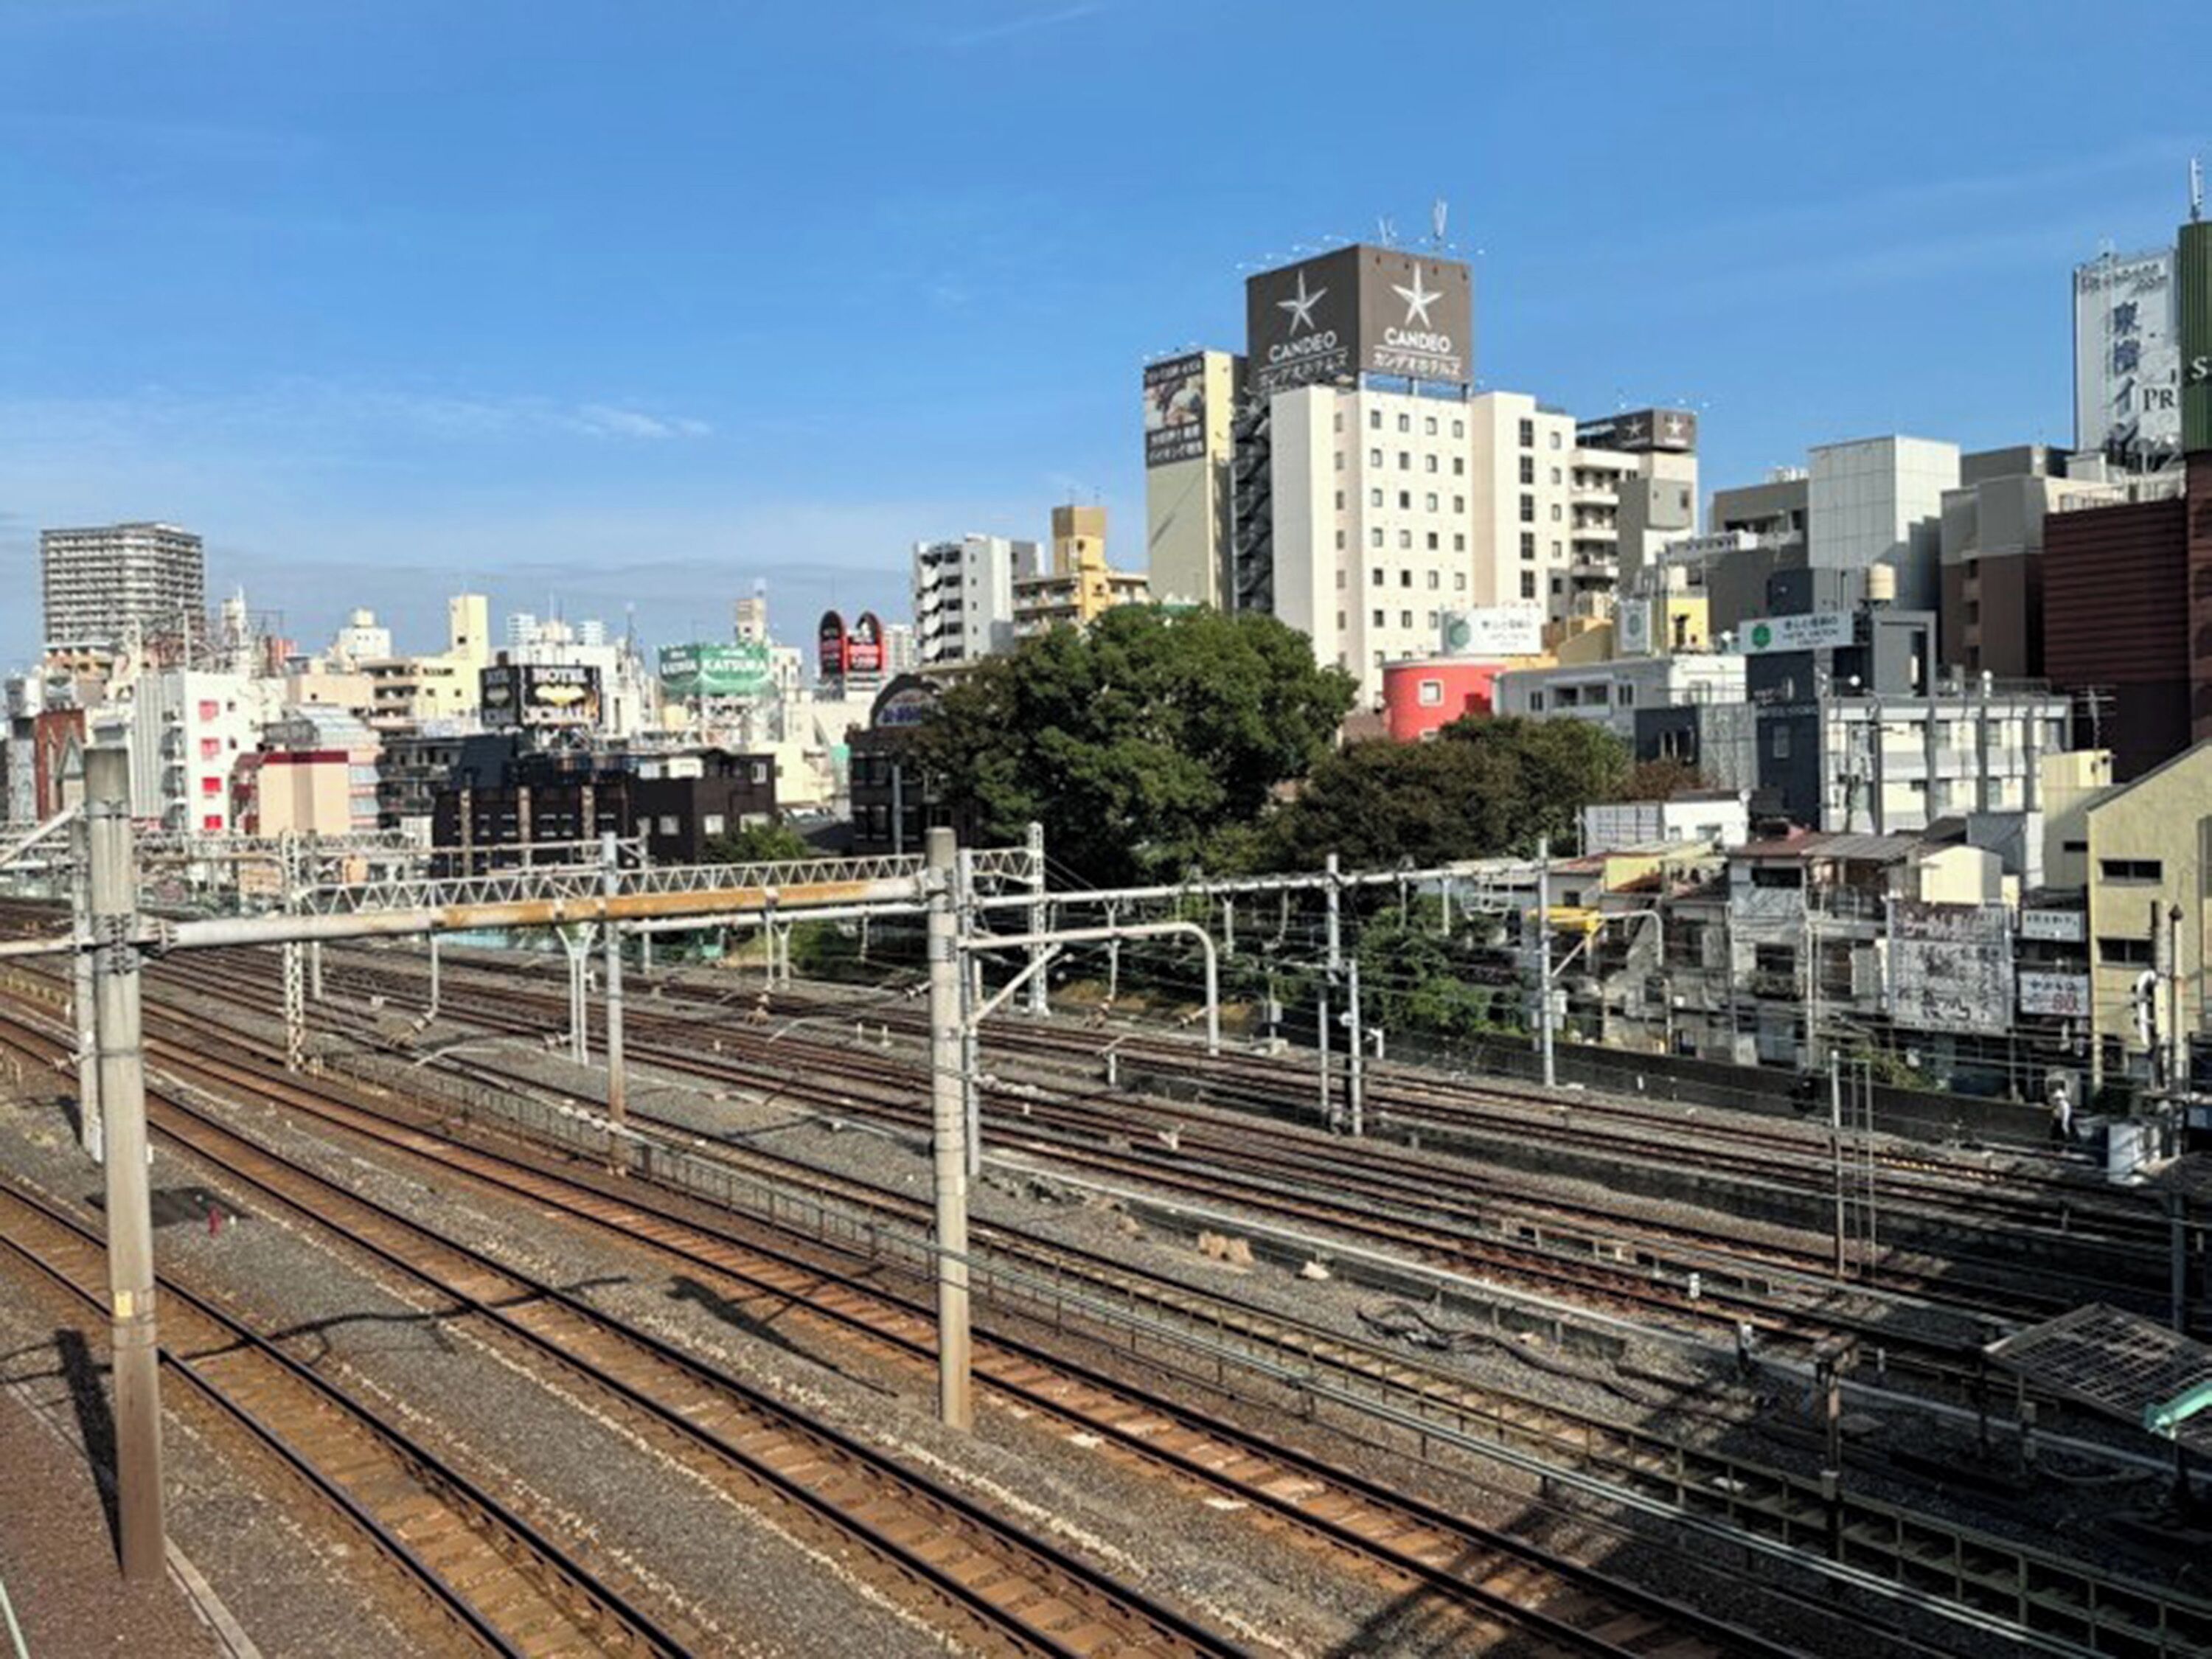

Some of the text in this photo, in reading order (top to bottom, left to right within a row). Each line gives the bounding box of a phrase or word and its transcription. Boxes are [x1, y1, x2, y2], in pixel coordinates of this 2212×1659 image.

[1268, 330, 1337, 363] CANDEO
[1385, 327, 1452, 353] CANDEO
[2191, 356, 2208, 380] S
[532, 667, 588, 684] HOTEL
